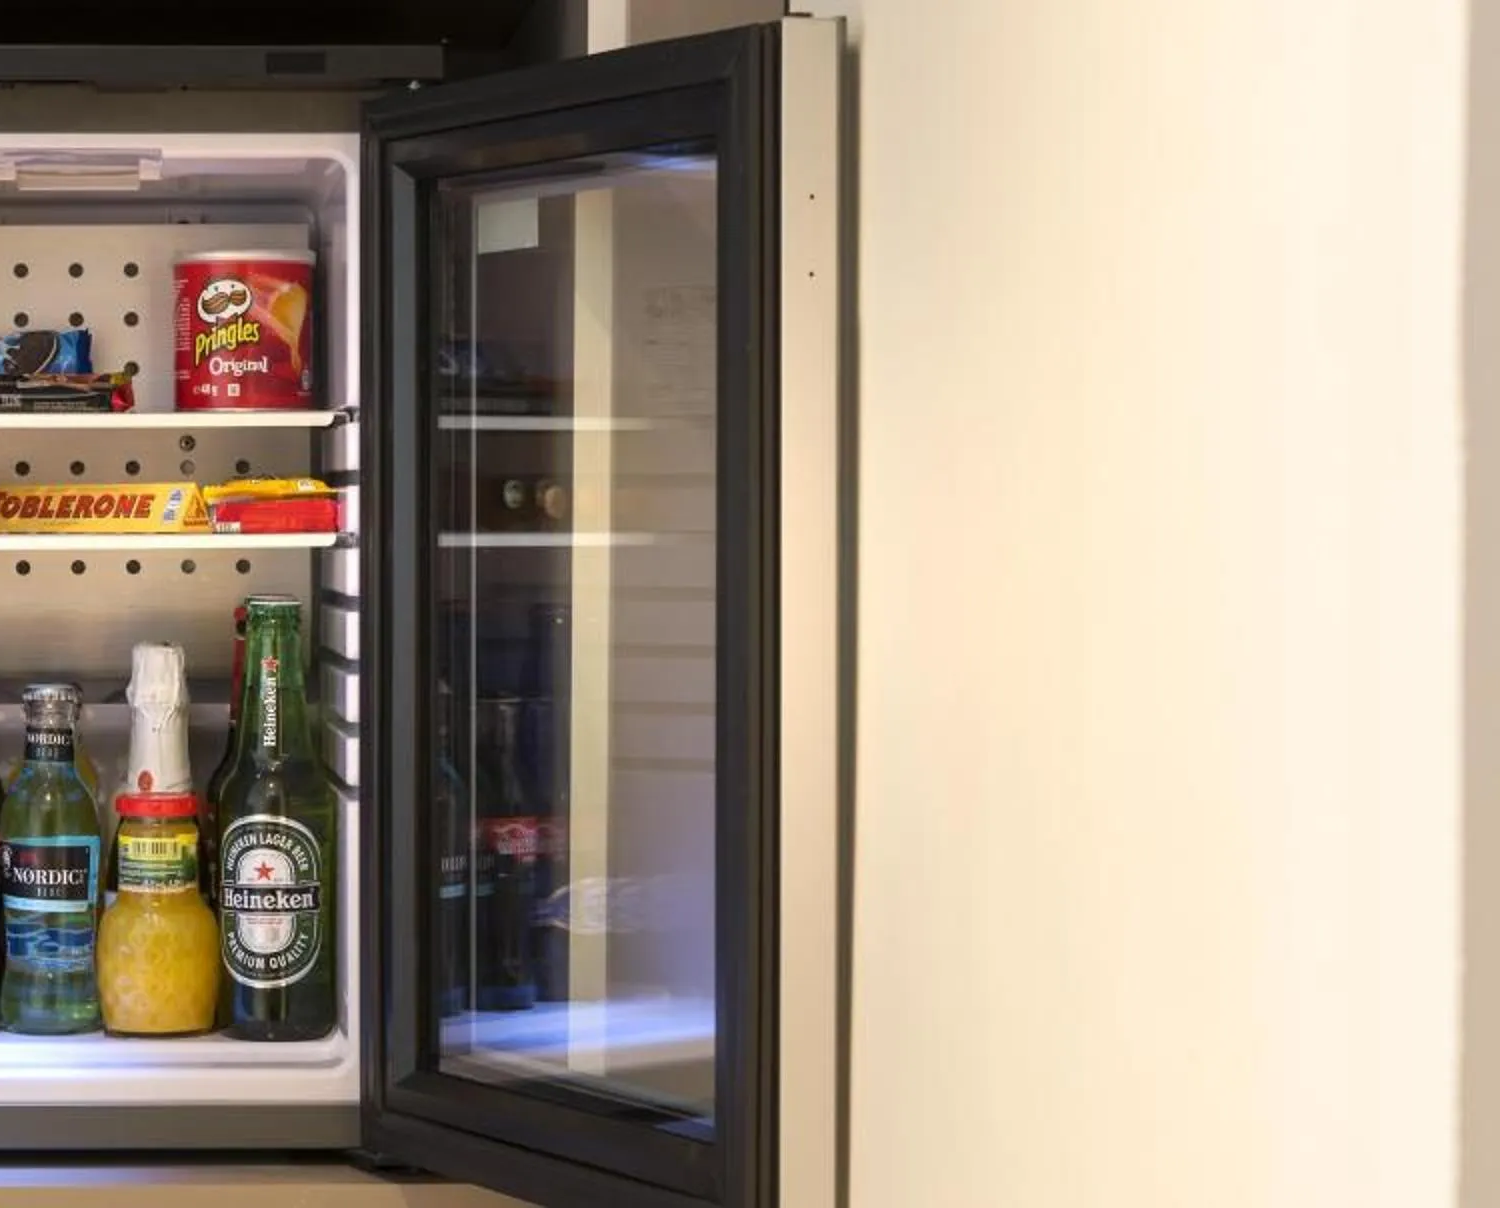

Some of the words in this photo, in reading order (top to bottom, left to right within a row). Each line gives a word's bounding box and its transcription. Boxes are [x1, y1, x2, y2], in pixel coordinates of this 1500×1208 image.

[195, 318, 260, 366] Pringles
[209, 355, 268, 377] Original
[263, 677, 277, 747] Heineken
[259, 832, 293, 851] LAGER
[223, 887, 315, 909] Heineken
[227, 931, 265, 969] PREMIUM
[269, 931, 309, 969] QUALITY
